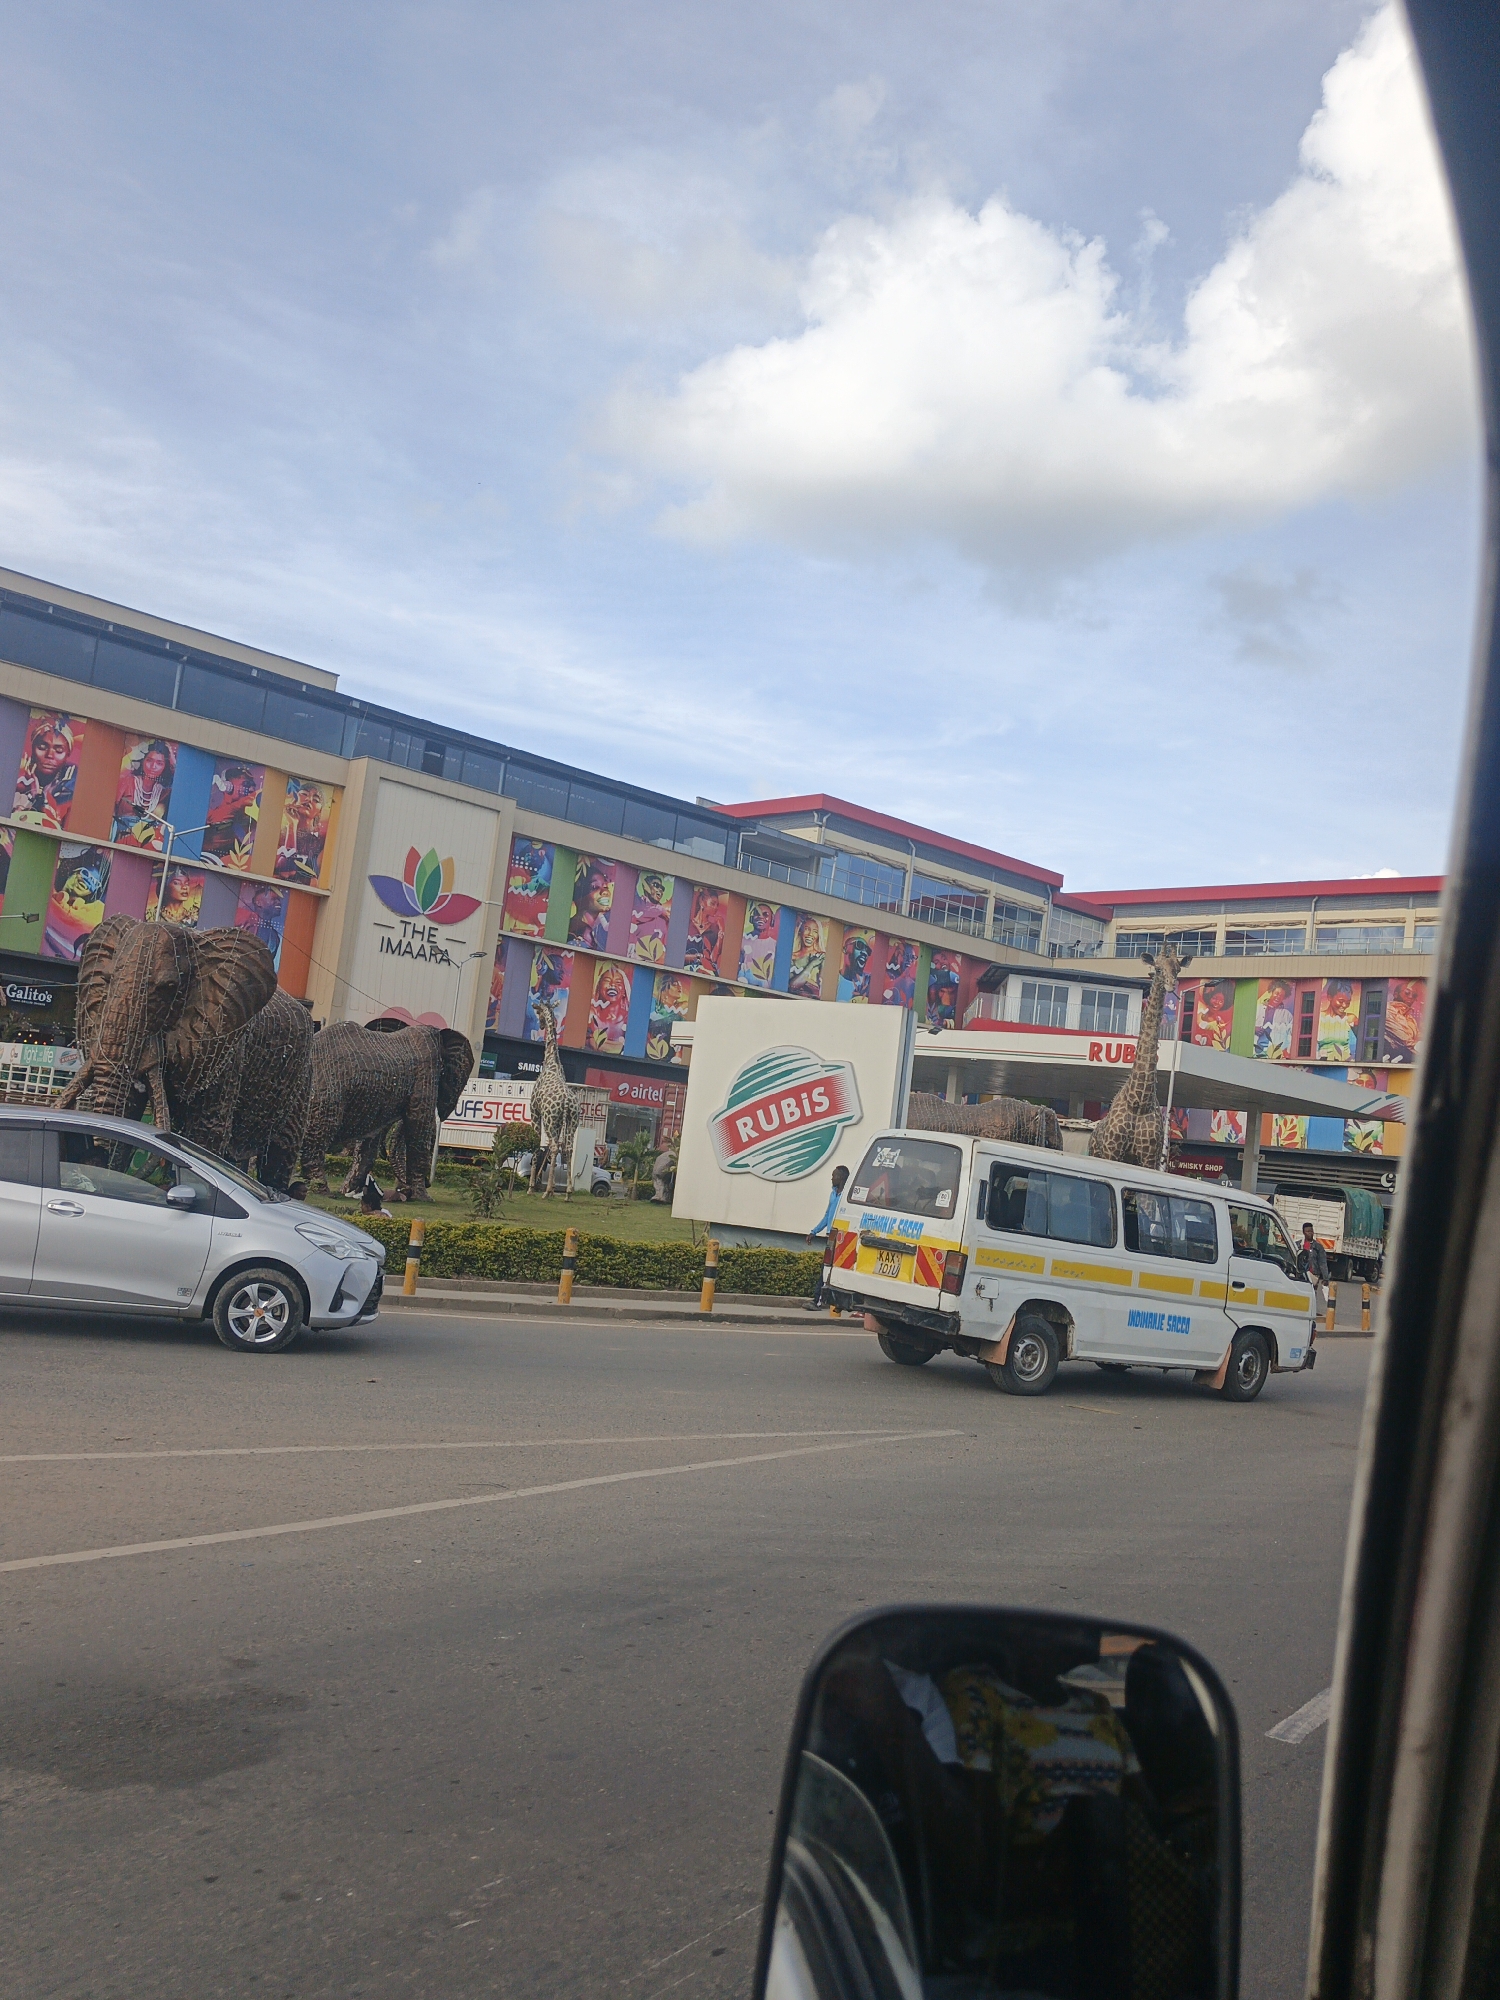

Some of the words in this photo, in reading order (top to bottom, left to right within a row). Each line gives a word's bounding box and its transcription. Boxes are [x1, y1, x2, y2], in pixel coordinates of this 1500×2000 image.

[400, 919, 439, 944] THE
[379, 935, 451, 966] IMAARA
[6, 984, 53, 1003] Galito's
[517, 1062, 543, 1073] SAMS
[630, 1083, 663, 1102] airtel
[454, 1099, 532, 1123] UFFSTEEL
[1178, 1161, 1203, 1171] WHISKY
[1204, 1164, 1223, 1172] SHOP
[897, 1218, 924, 1240] SACCO
[1127, 1309, 1165, 1331] INDIMANJE
[1166, 1314, 1191, 1335] SACCO
